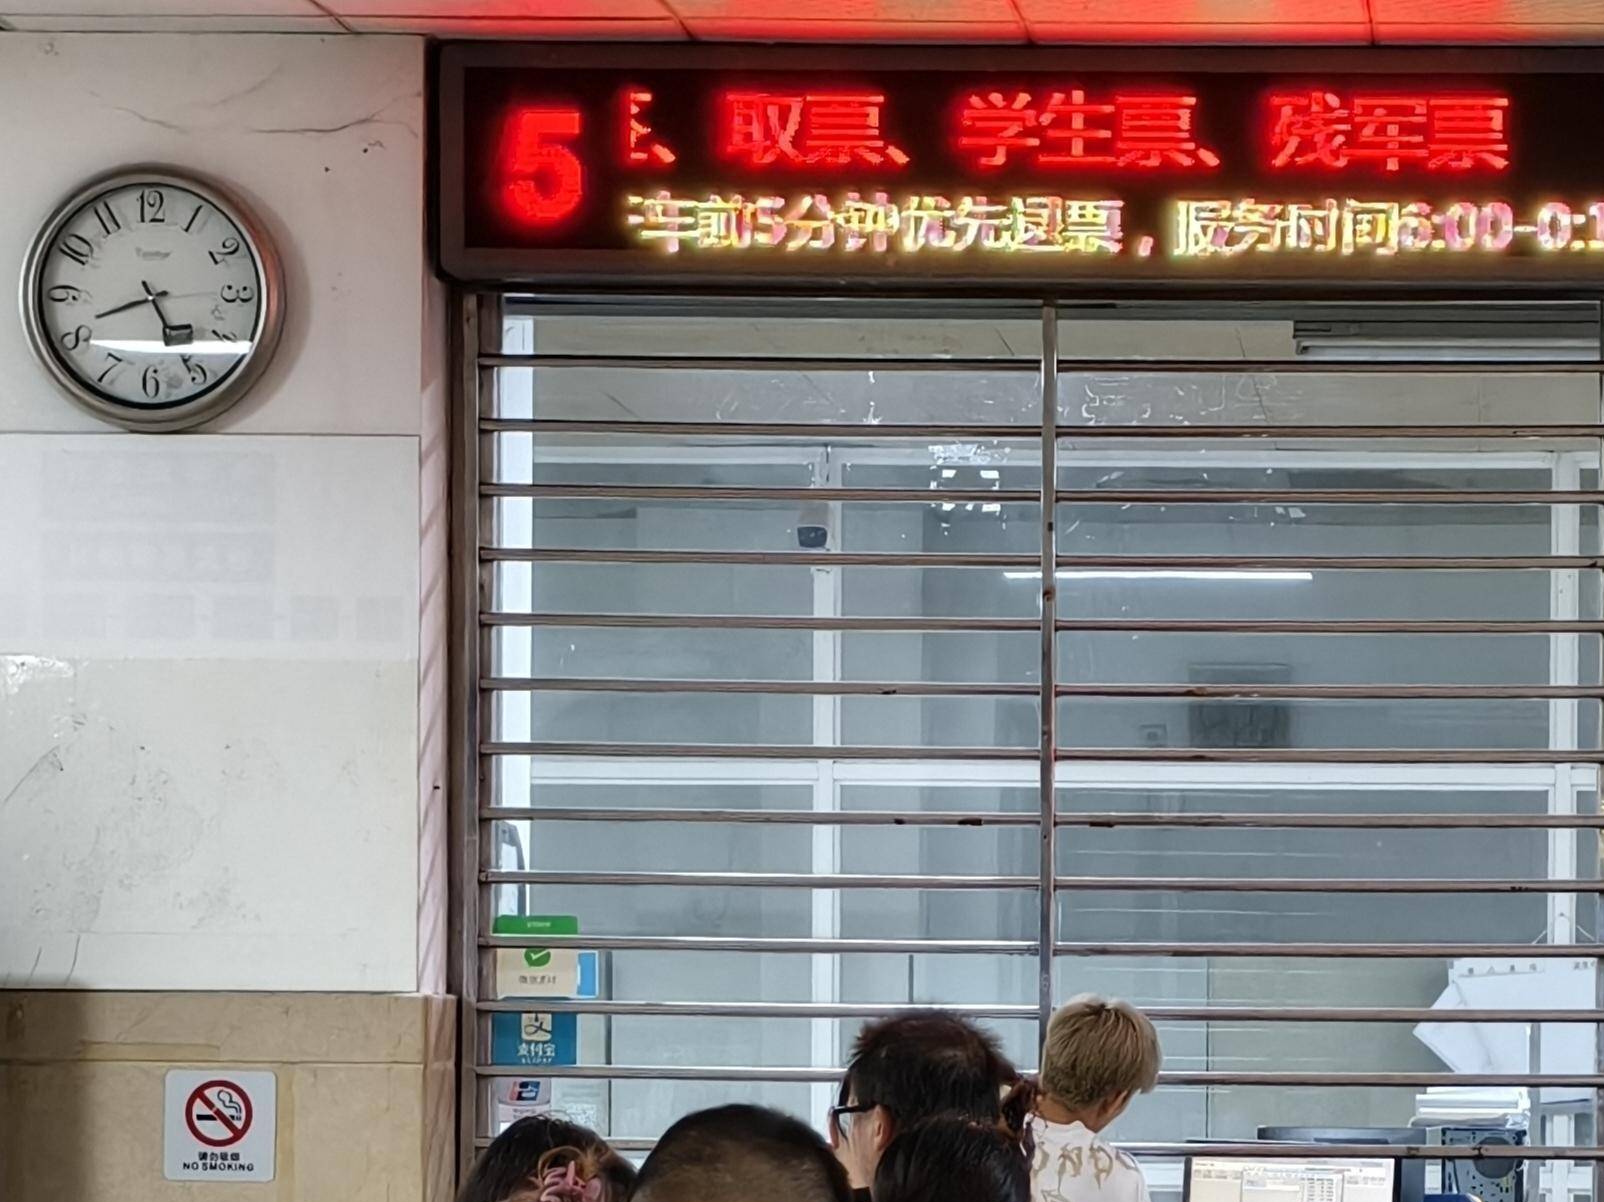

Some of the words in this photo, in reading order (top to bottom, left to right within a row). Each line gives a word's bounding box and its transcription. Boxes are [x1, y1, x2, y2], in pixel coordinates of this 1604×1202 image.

[629, 90, 1509, 170] 、取票、学生票、残军票
[508, 109, 583, 222] 5
[93, 200, 122, 236] 11
[136, 189, 165, 224] 12
[183, 204, 204, 233] 1
[58, 233, 94, 267] 10
[208, 236, 241, 266] 2
[48, 284, 85, 304] 9
[220, 284, 255, 304] 3
[60, 324, 93, 352] 8
[97, 351, 124, 384] 7
[141, 364, 161, 399] 6
[179, 353, 208, 385] 5
[182, 1161, 199, 1171] NO
[201, 1162, 255, 1172] SMOKING
